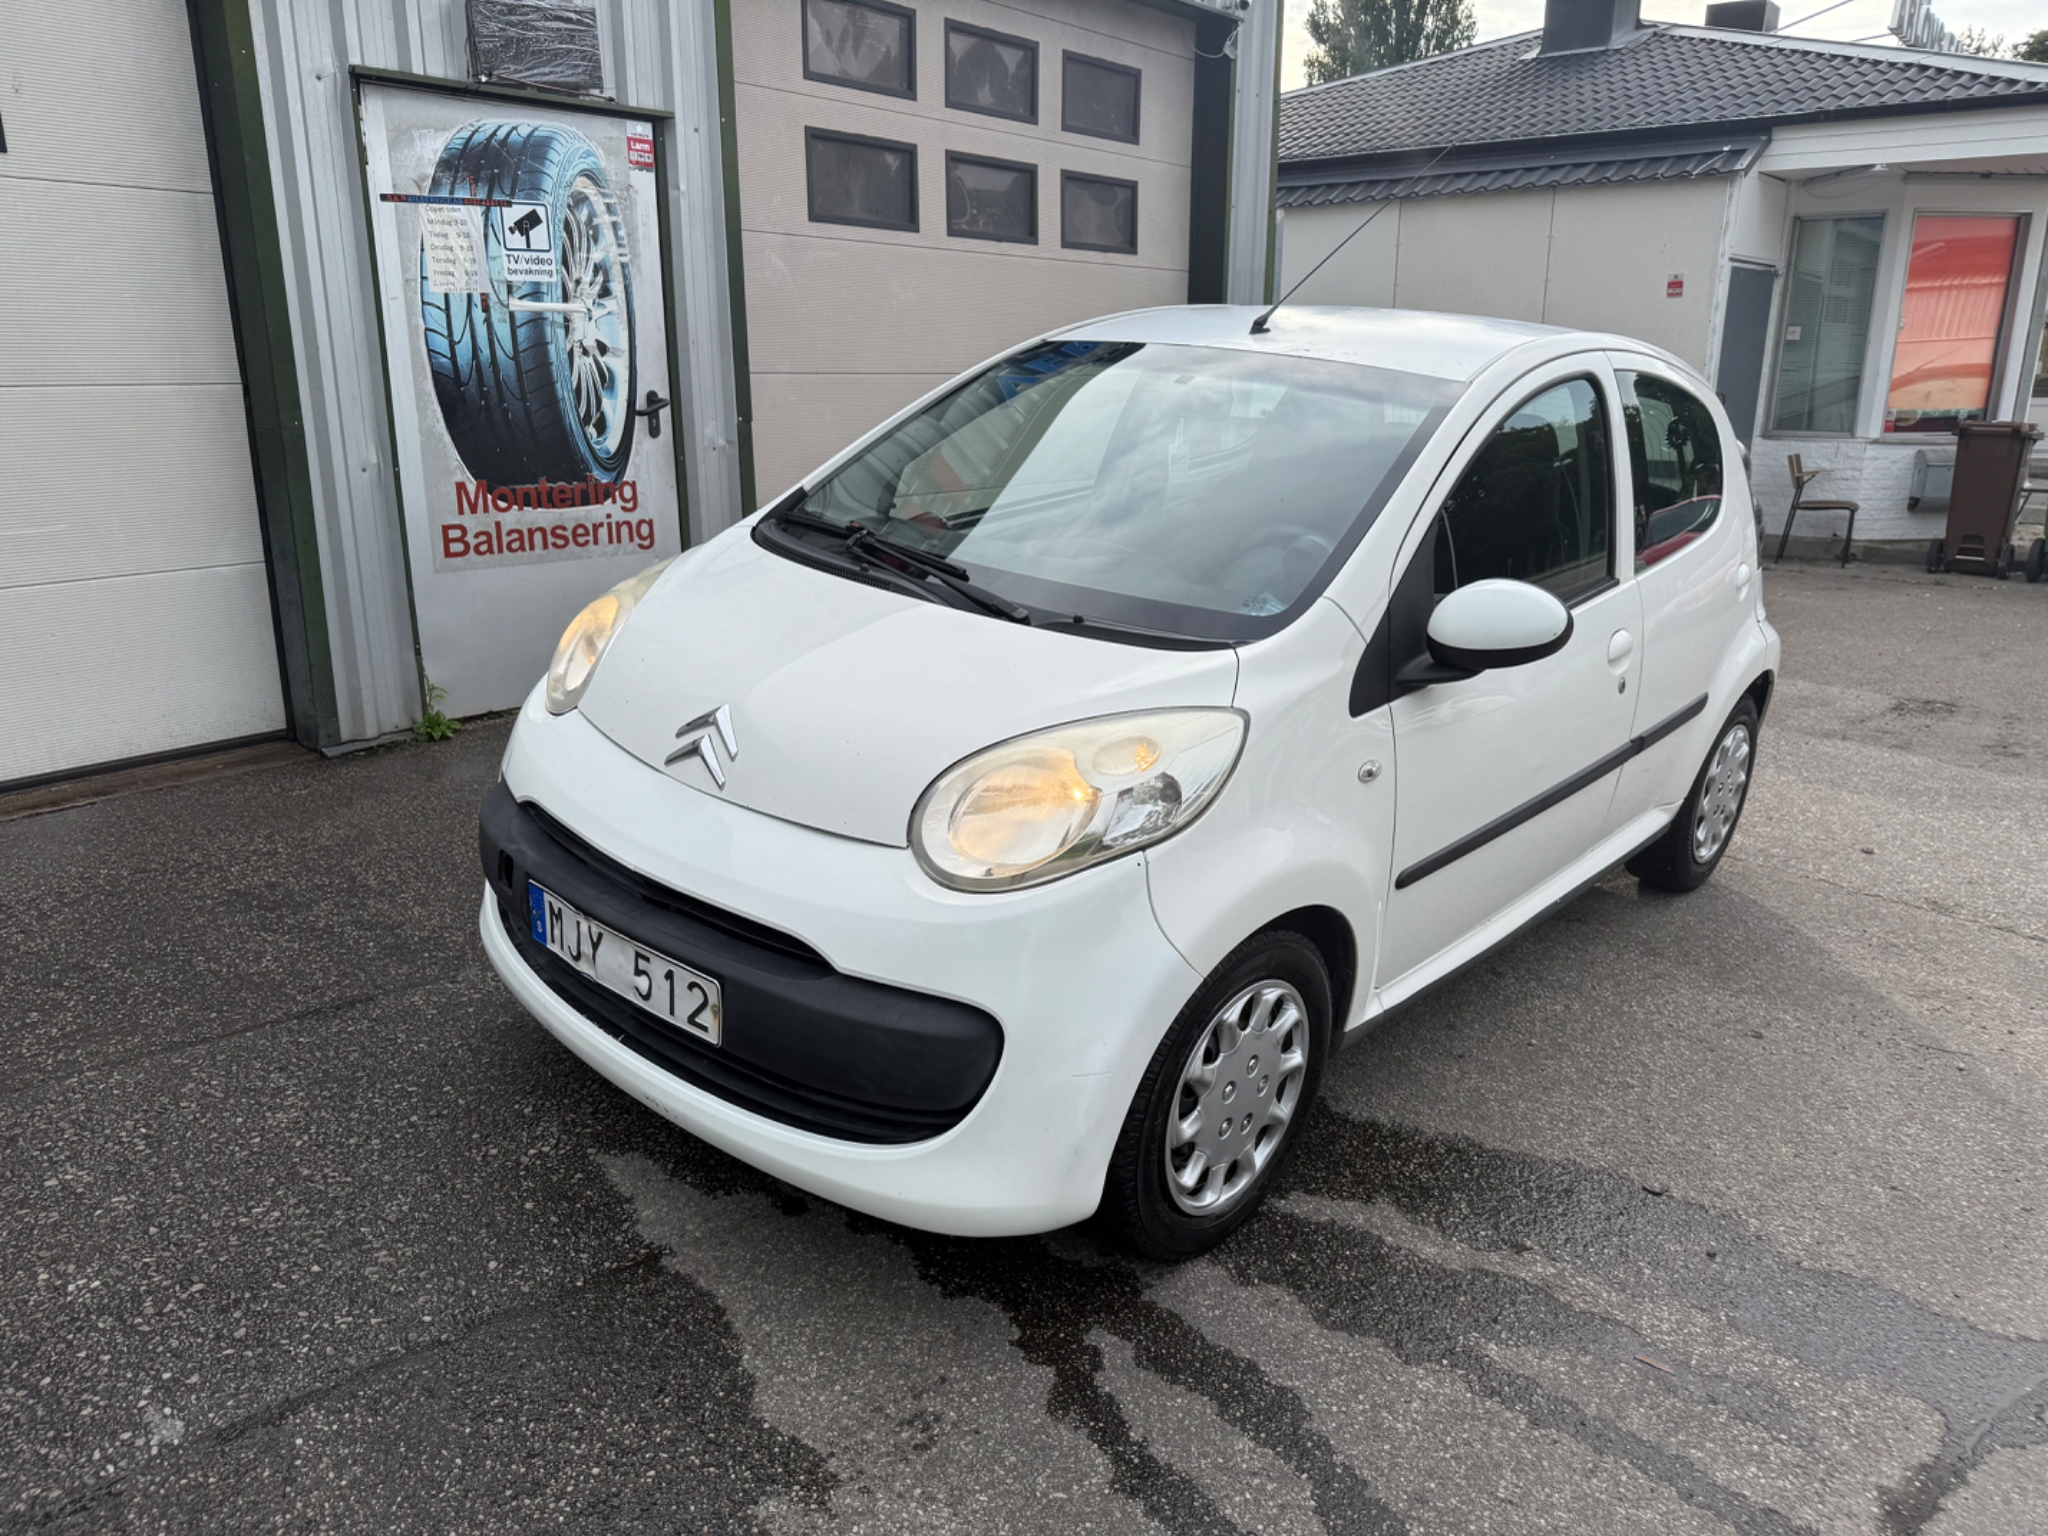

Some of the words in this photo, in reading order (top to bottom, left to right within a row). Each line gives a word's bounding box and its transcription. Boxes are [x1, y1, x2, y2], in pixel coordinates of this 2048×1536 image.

[505, 253, 553, 266] TV/video
[507, 267, 553, 278] bevakning
[455, 474, 638, 515] Montering
[441, 513, 655, 559] Balansering
[549, 900, 603, 971] MJY
[634, 950, 709, 1034] 512
